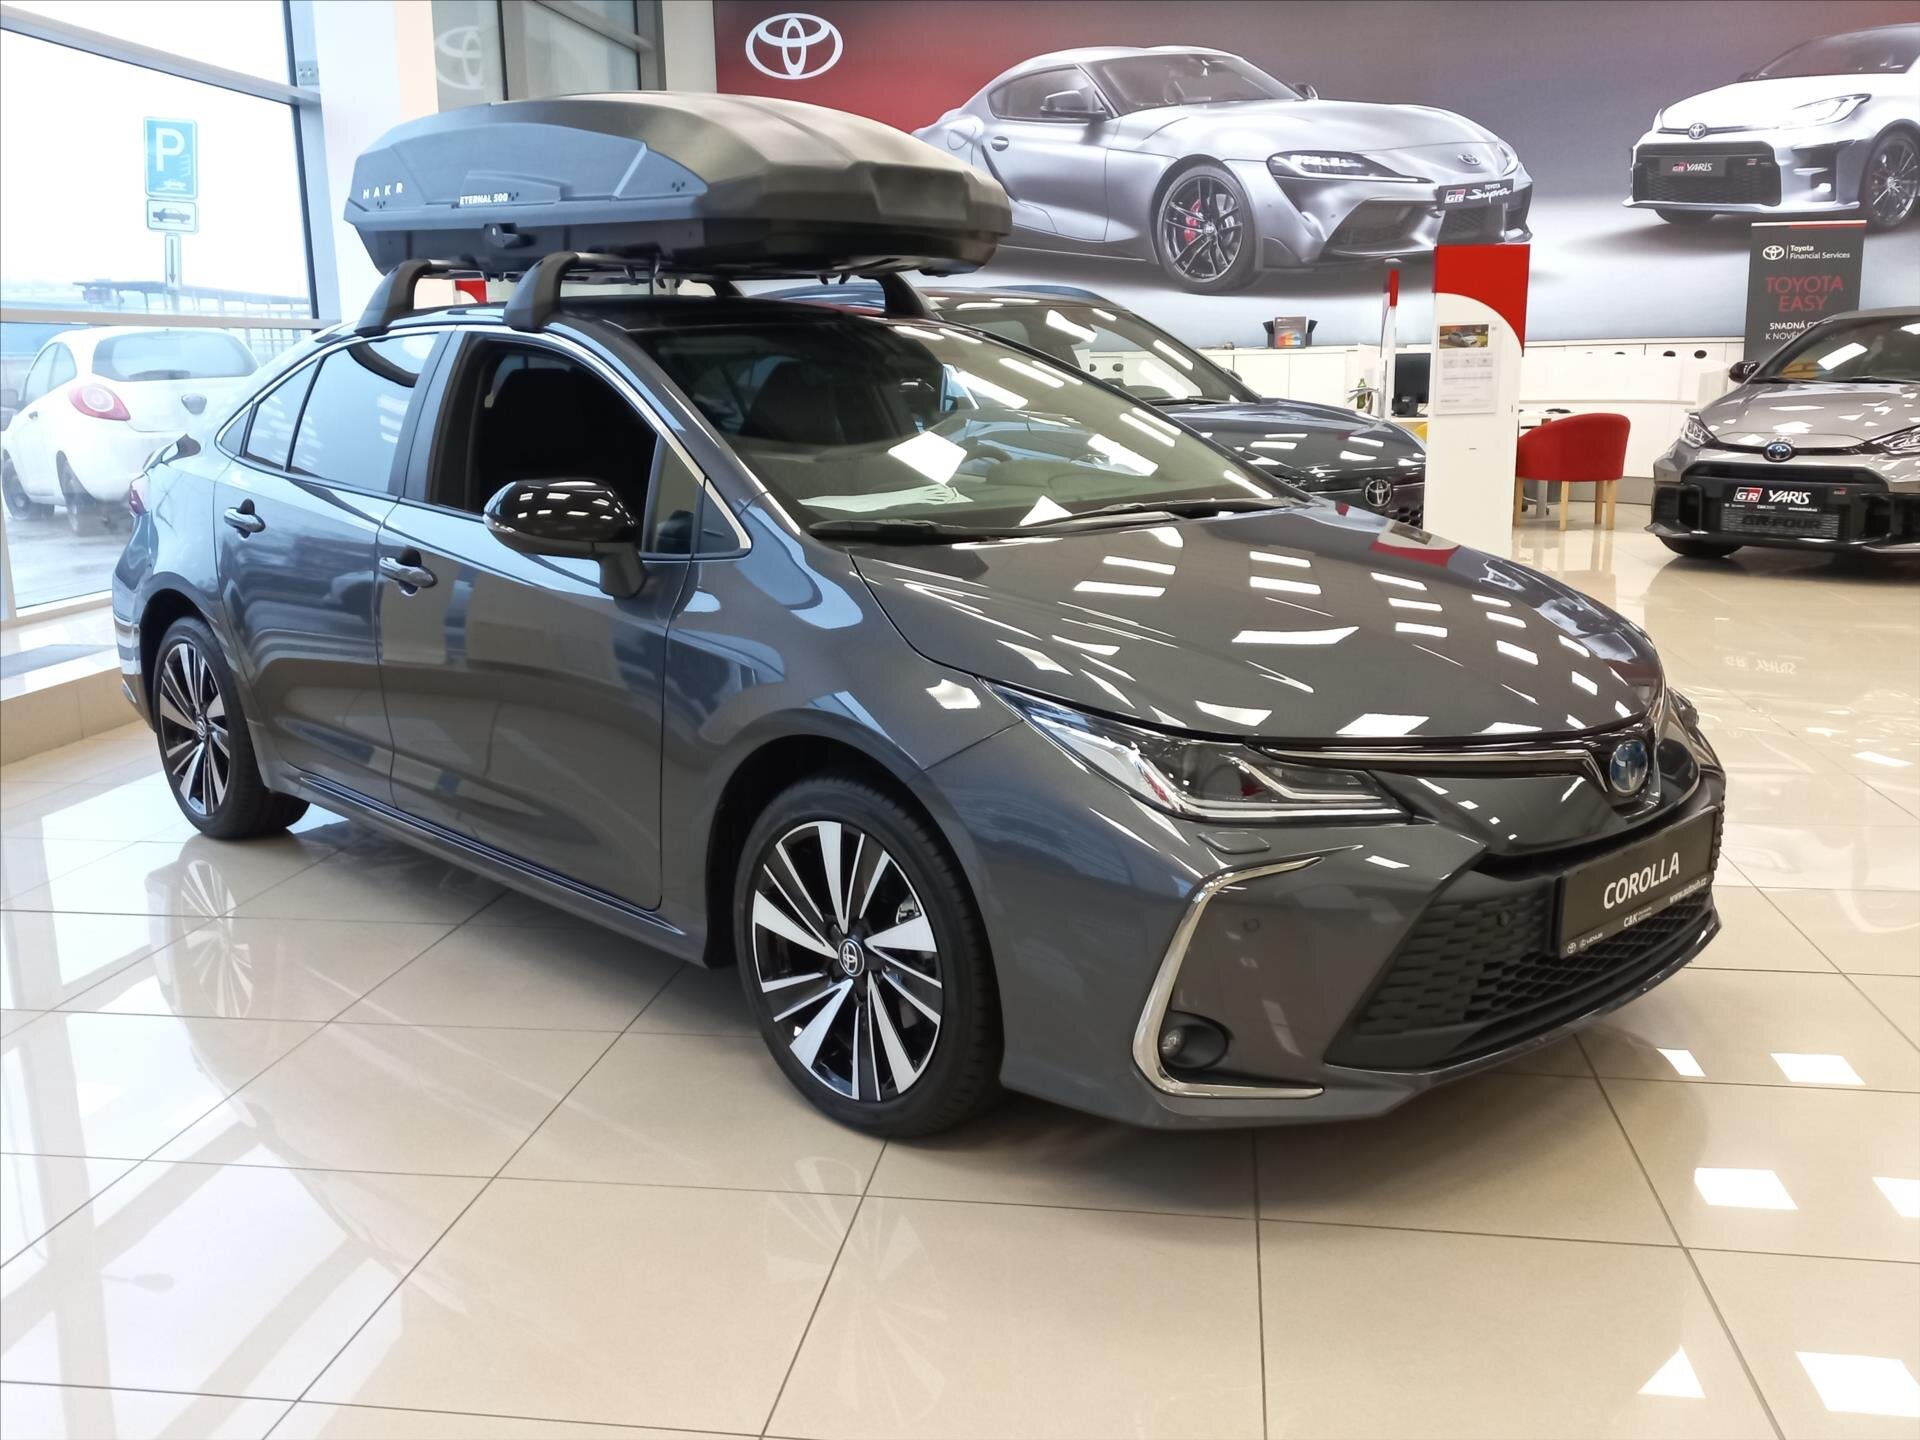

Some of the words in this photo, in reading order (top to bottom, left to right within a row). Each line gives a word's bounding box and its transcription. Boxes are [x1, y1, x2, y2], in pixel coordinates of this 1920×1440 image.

[155, 127, 185, 172] P
[1687, 162, 1713, 172] YARIS
[459, 195, 491, 206] ETERNAL
[493, 192, 509, 203] 500
[1445, 192, 1465, 203] GR
[1466, 187, 1512, 204] Supra
[1790, 244, 1814, 252] Toyota
[1789, 252, 1821, 260] Financial
[1766, 275, 1844, 294] TOYOTA
[1779, 295, 1828, 312] EASY
[1769, 320, 1806, 330] SNADNÁ
[1765, 332, 1771, 340] K
[1735, 490, 1760, 501] GR
[1768, 489, 1811, 505] YARIS
[1603, 852, 1680, 909] COROLLA
